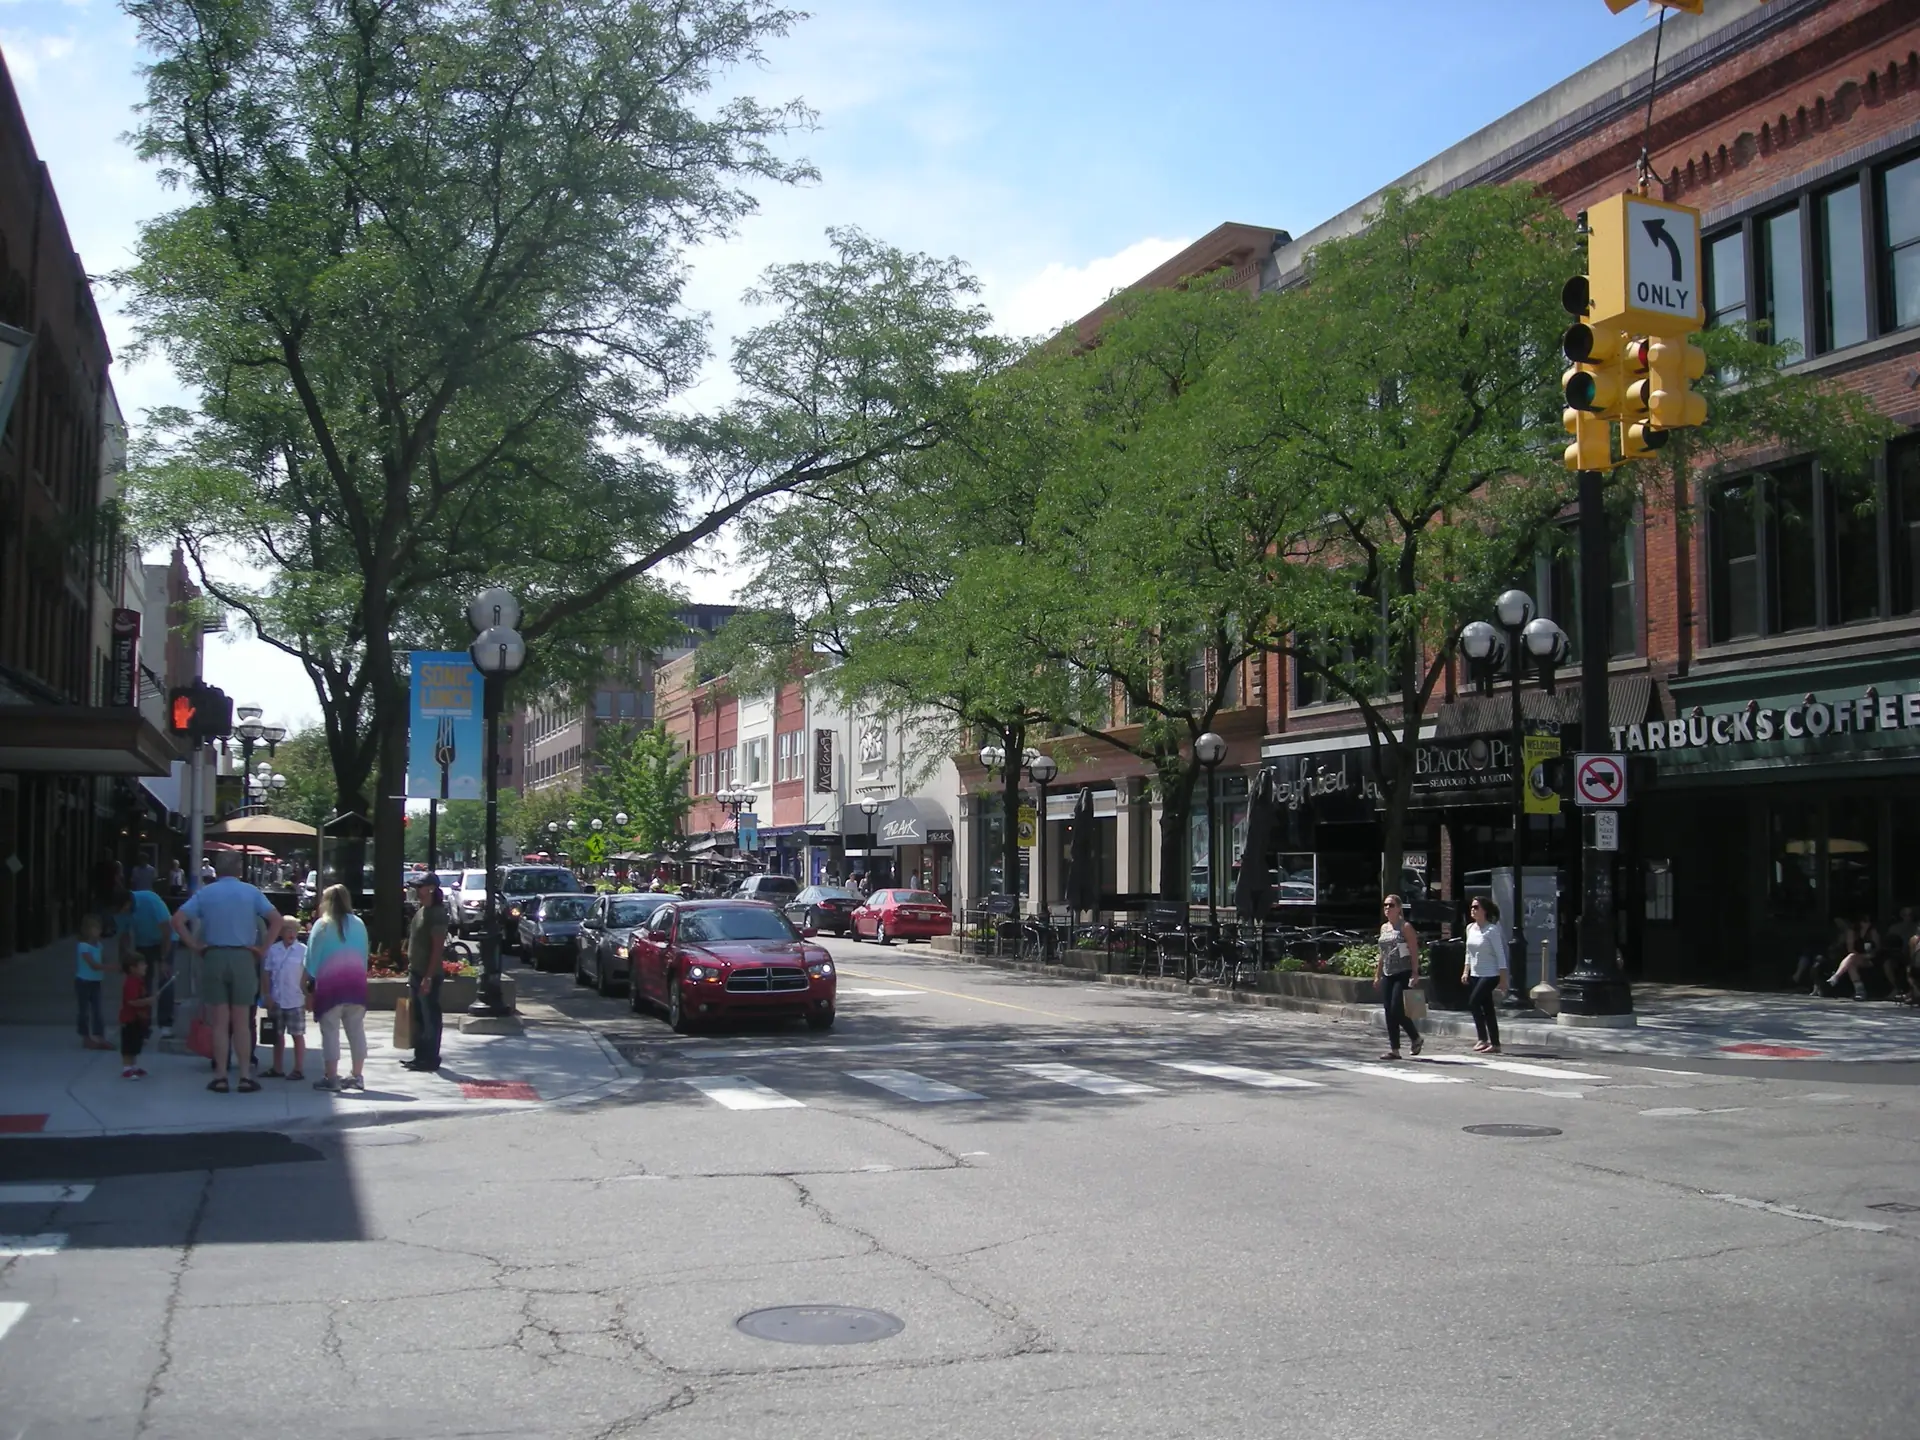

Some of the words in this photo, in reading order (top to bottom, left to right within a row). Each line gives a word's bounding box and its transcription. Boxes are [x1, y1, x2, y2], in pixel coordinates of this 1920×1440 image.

[1637, 281, 1689, 310] ONLY
[421, 664, 473, 687] SONIC
[420, 689, 473, 709] LUNCH
[1609, 707, 1775, 752] TARBUCKS
[1783, 691, 1920, 739] COFFEE
[1526, 740, 1560, 753] WELCOME
[1415, 747, 1470, 774] BLACK
[1429, 777, 1467, 788] SEAFOOD
[1469, 775, 1477, 785] &
[1479, 773, 1513, 784] MARTIN
[1409, 855, 1426, 865] GOLD
